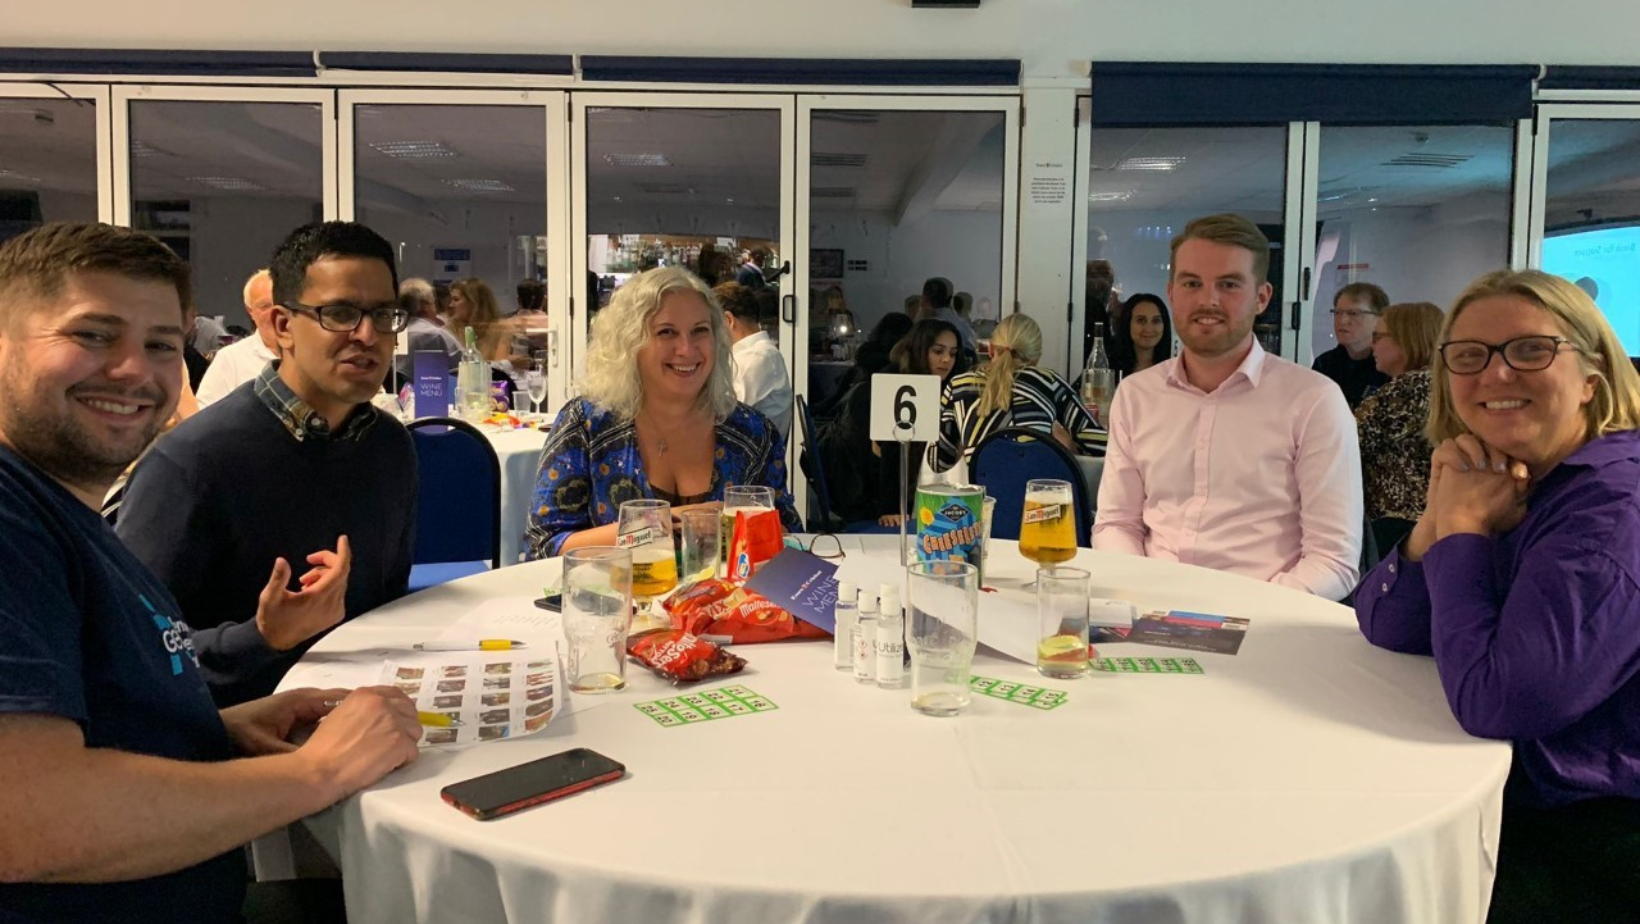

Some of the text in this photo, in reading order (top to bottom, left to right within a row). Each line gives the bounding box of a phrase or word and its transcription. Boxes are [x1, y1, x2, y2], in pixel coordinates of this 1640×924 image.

[894, 385, 917, 430] 6
[802, 575, 837, 606] WINE
[814, 588, 838, 613] MEN
